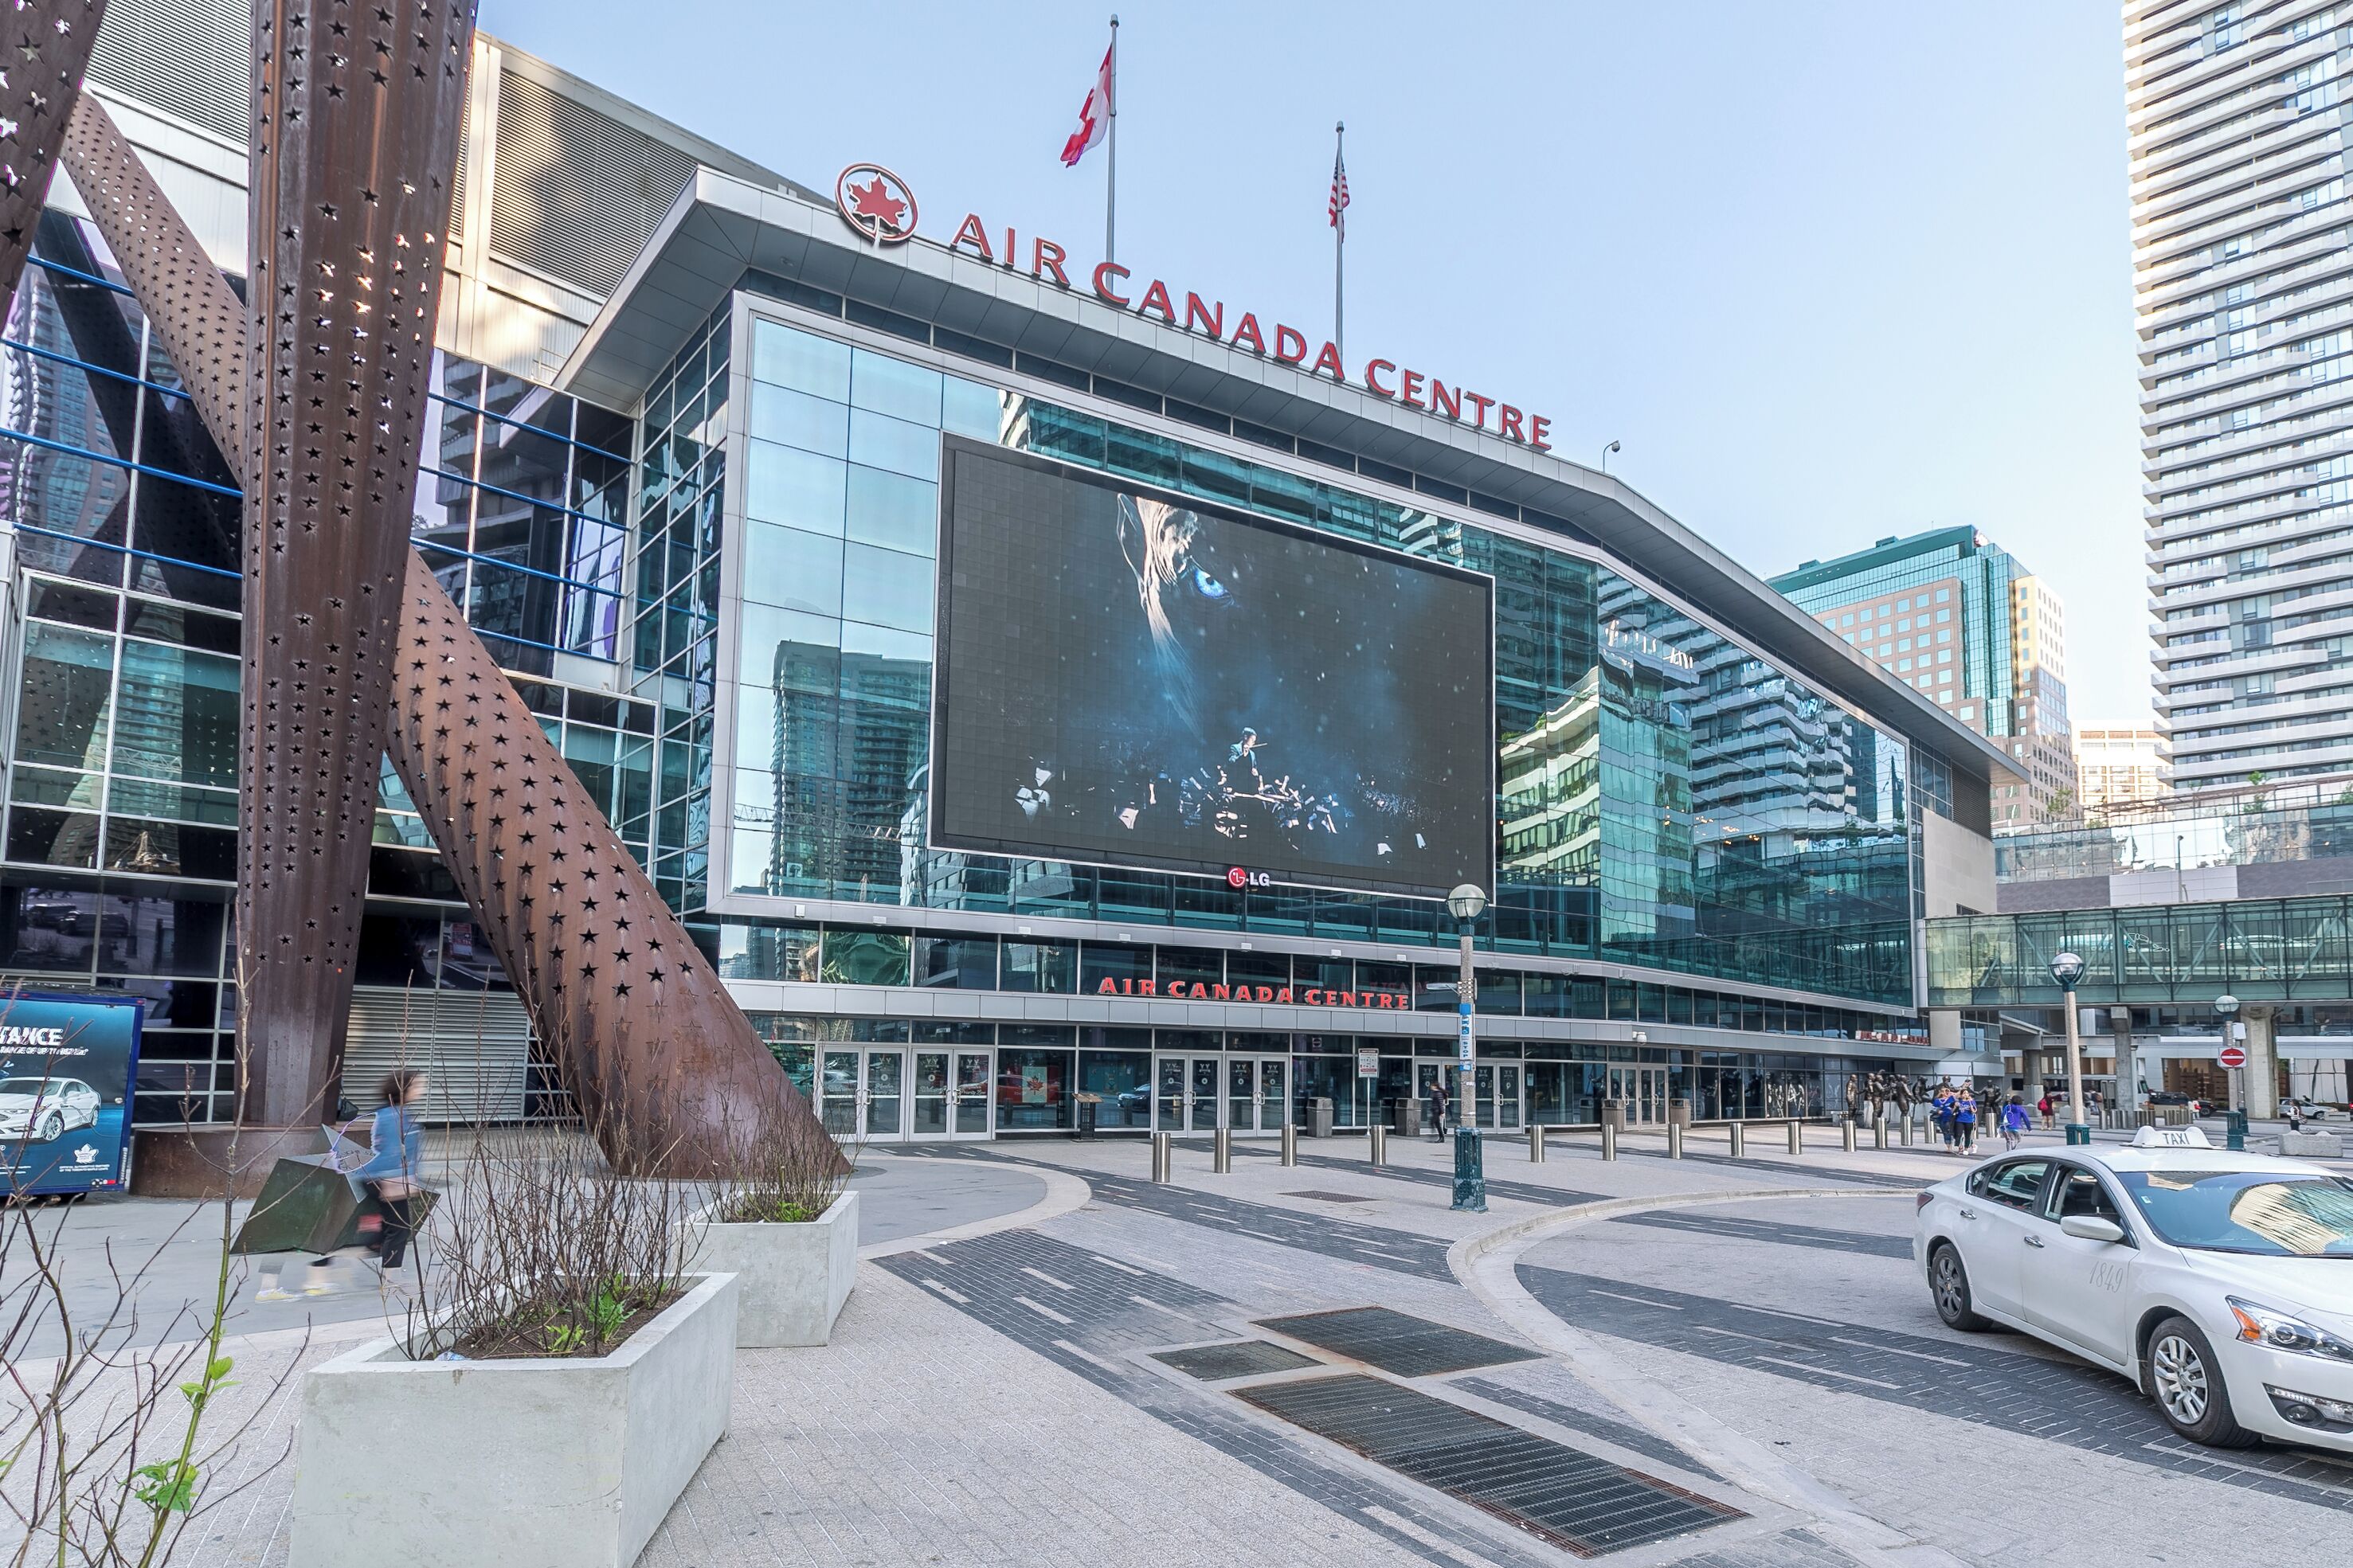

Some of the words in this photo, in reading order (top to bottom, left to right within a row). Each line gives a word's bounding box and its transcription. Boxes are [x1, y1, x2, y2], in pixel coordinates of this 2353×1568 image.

[950, 213, 1071, 289] AIR
[1092, 261, 1345, 382] CANADA
[1364, 358, 1552, 452] CENTRE
[1250, 872, 1270, 886] LG
[1098, 977, 1155, 995] AIR
[1168, 980, 1293, 1003] CANADA
[1305, 989, 1409, 1010] CENTRE
[2163, 1132, 2190, 1145] TAXI
[2089, 1261, 2124, 1293] 1849
